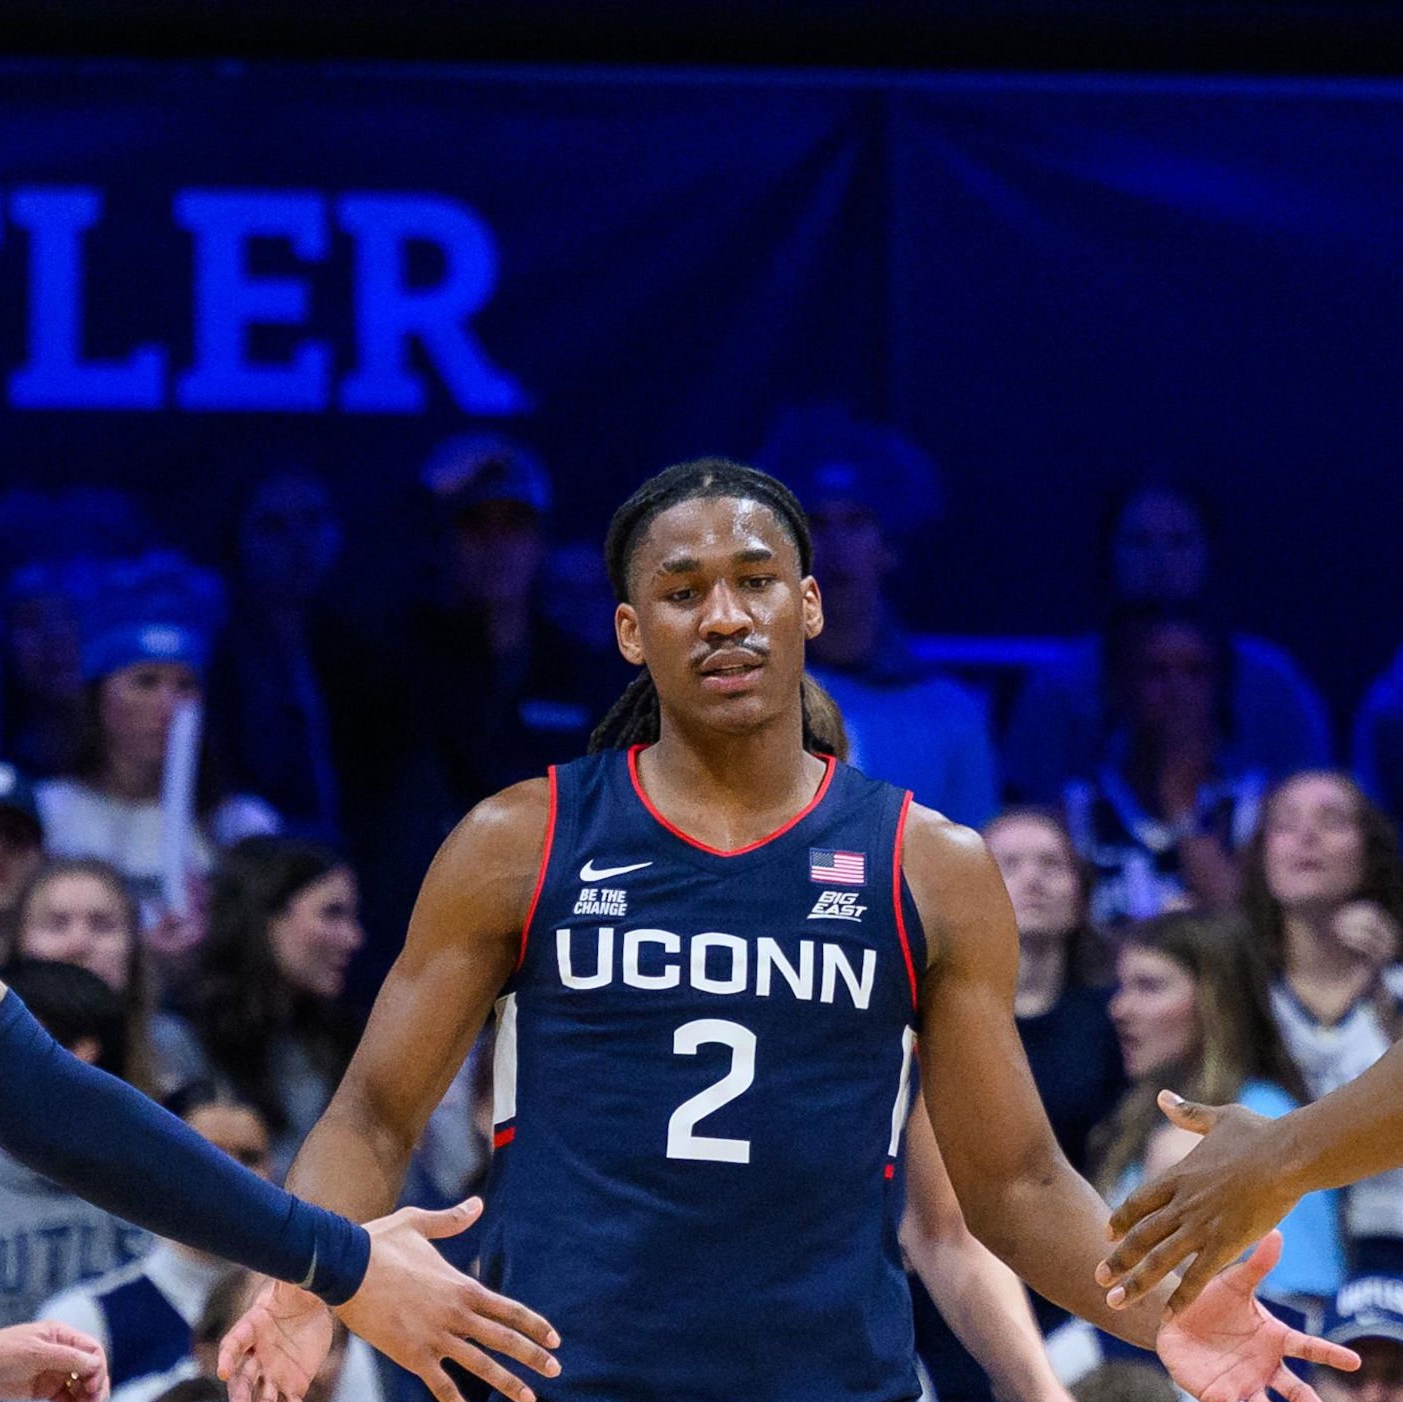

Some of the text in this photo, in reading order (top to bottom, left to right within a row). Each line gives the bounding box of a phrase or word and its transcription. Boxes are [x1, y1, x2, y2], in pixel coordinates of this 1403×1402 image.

[579, 888, 627, 904] BE THE
[817, 890, 860, 905] BIG
[573, 901, 628, 917] CHANGE
[810, 903, 868, 918] EAST
[556, 927, 877, 1010] UCONN
[666, 1018, 758, 1164] 2
